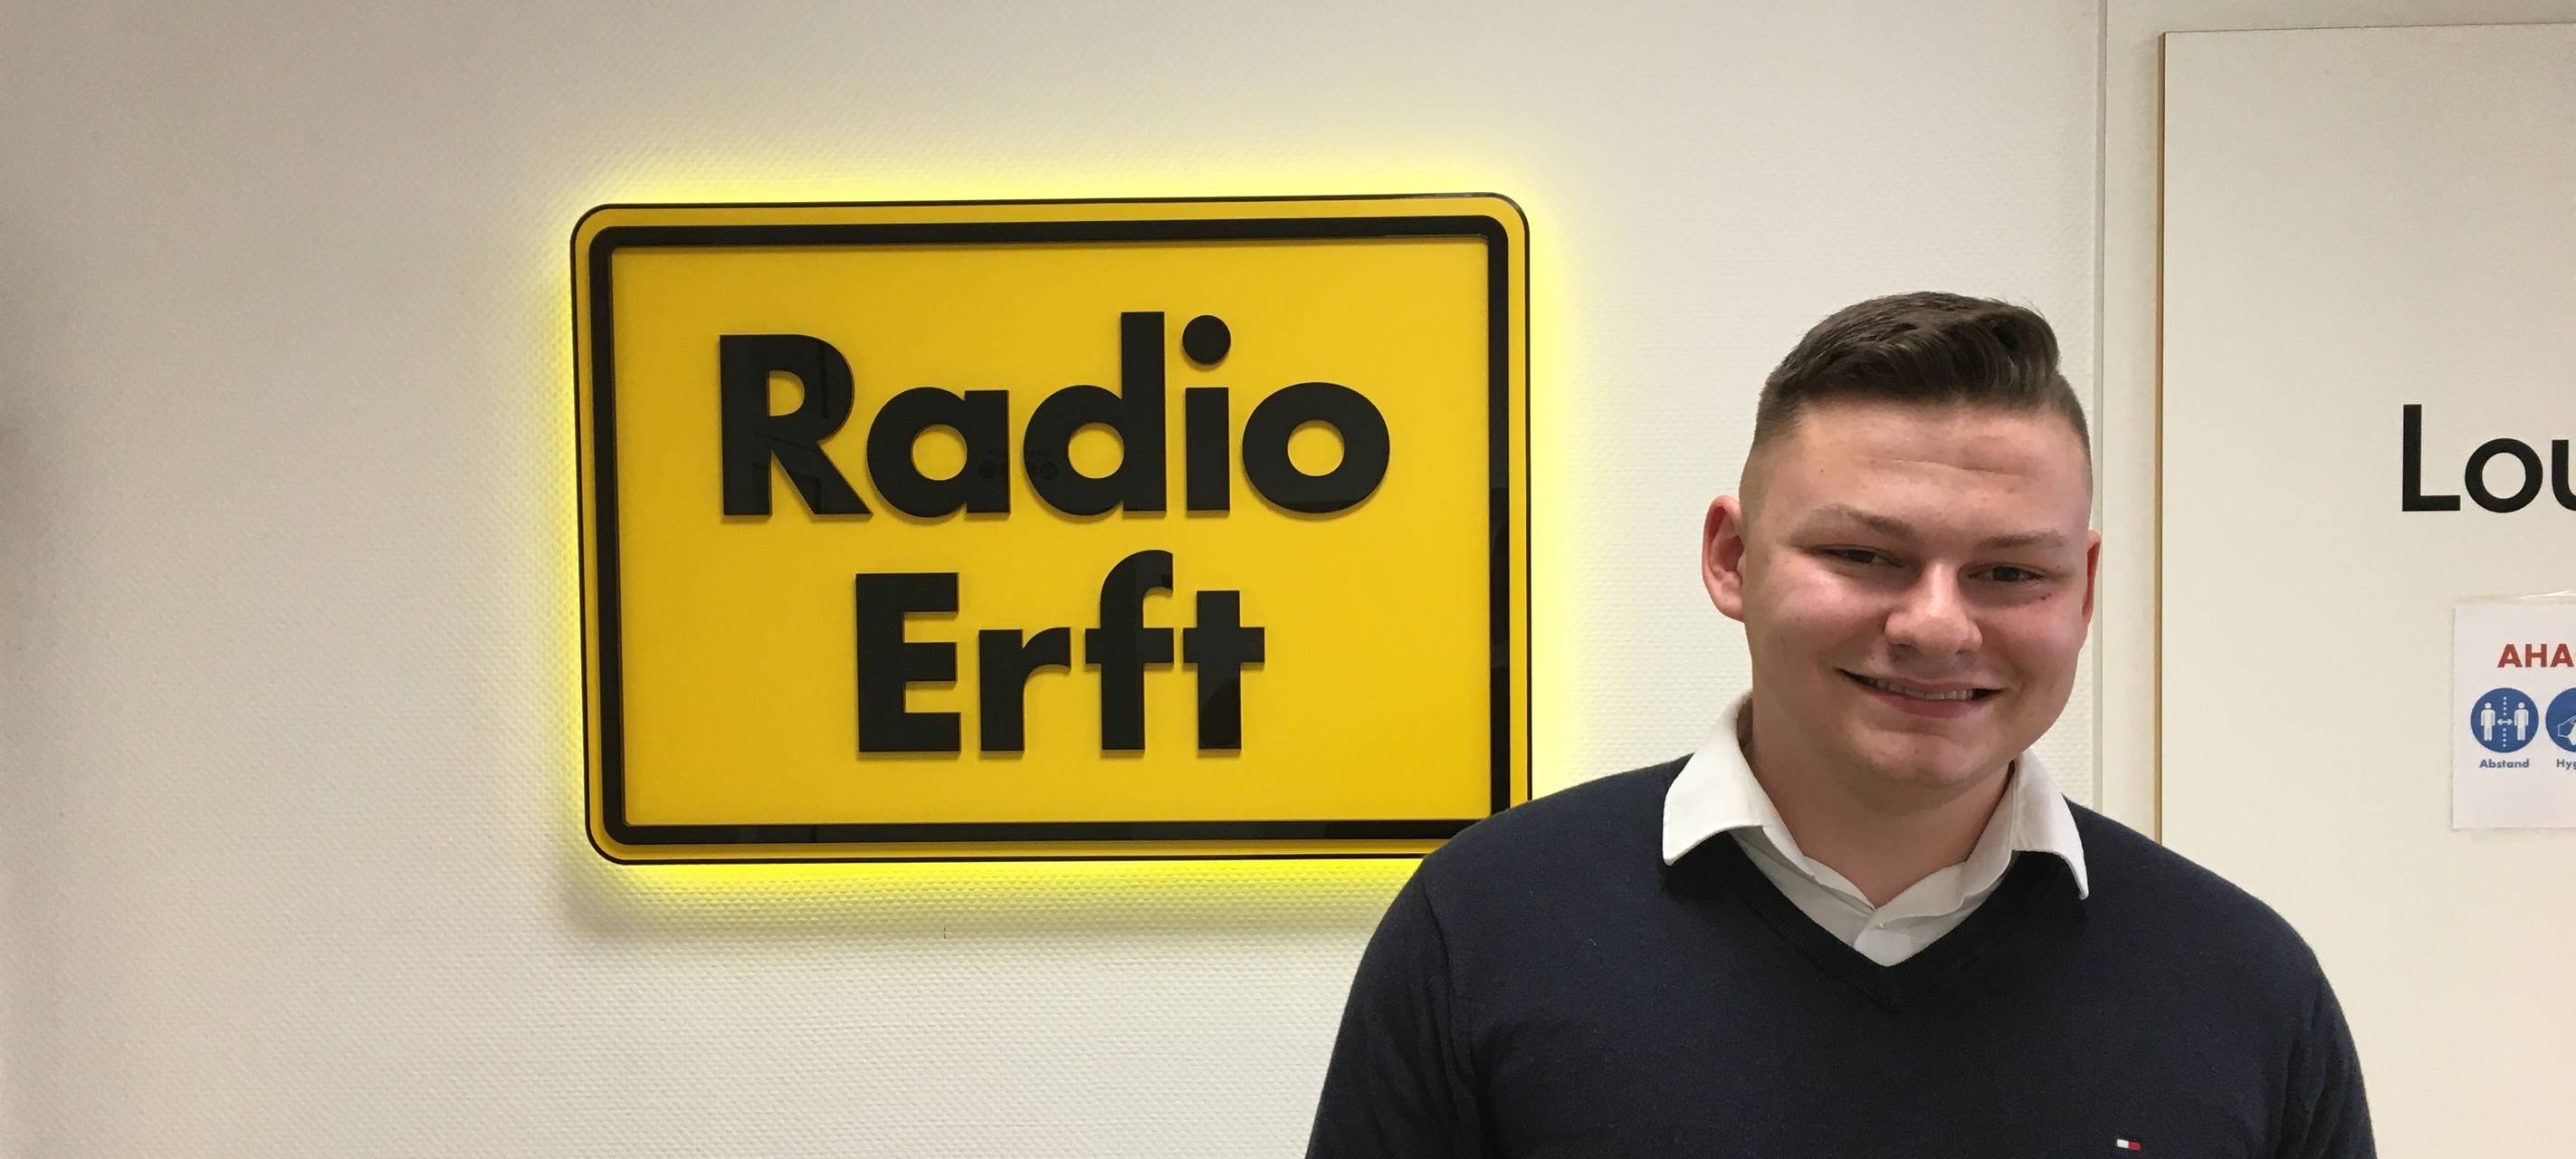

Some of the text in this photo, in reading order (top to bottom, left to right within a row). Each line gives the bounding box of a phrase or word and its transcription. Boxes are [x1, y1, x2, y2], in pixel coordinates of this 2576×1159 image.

[718, 310, 1392, 520] Radio
[854, 549, 1265, 754] Erft
[2479, 758, 2530, 769] Abstand
